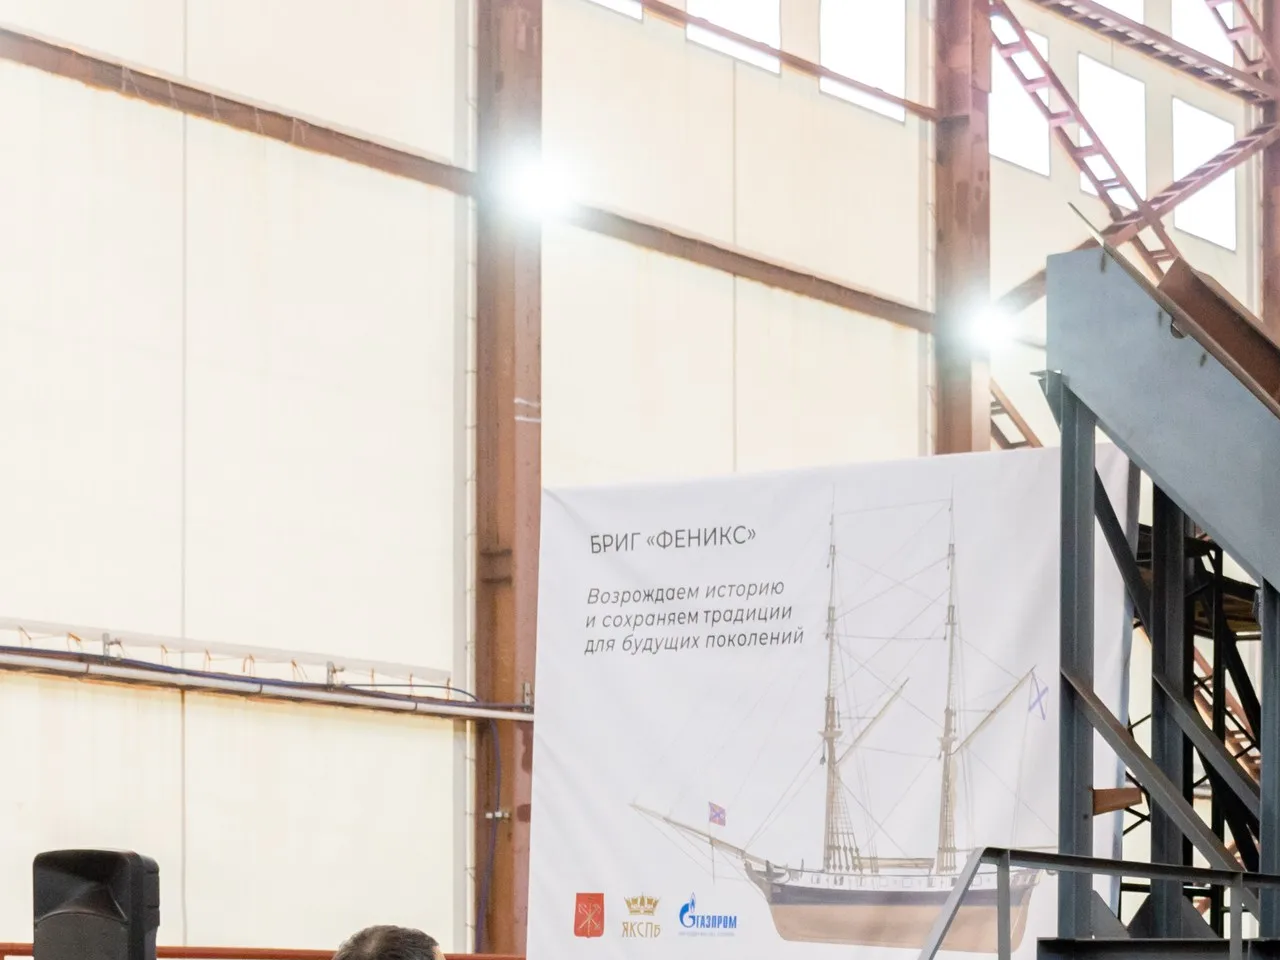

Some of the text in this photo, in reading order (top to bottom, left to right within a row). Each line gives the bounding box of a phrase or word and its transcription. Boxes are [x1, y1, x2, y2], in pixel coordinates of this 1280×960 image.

[590, 525, 756, 554] БРИГ «ФЕНИКС»
[587, 580, 785, 607] Возрождаем историю
[585, 605, 792, 631] и сохраняем традиции
[584, 626, 804, 656] для будущих поколений
[696, 915, 737, 929] ГАЗПРОМ
